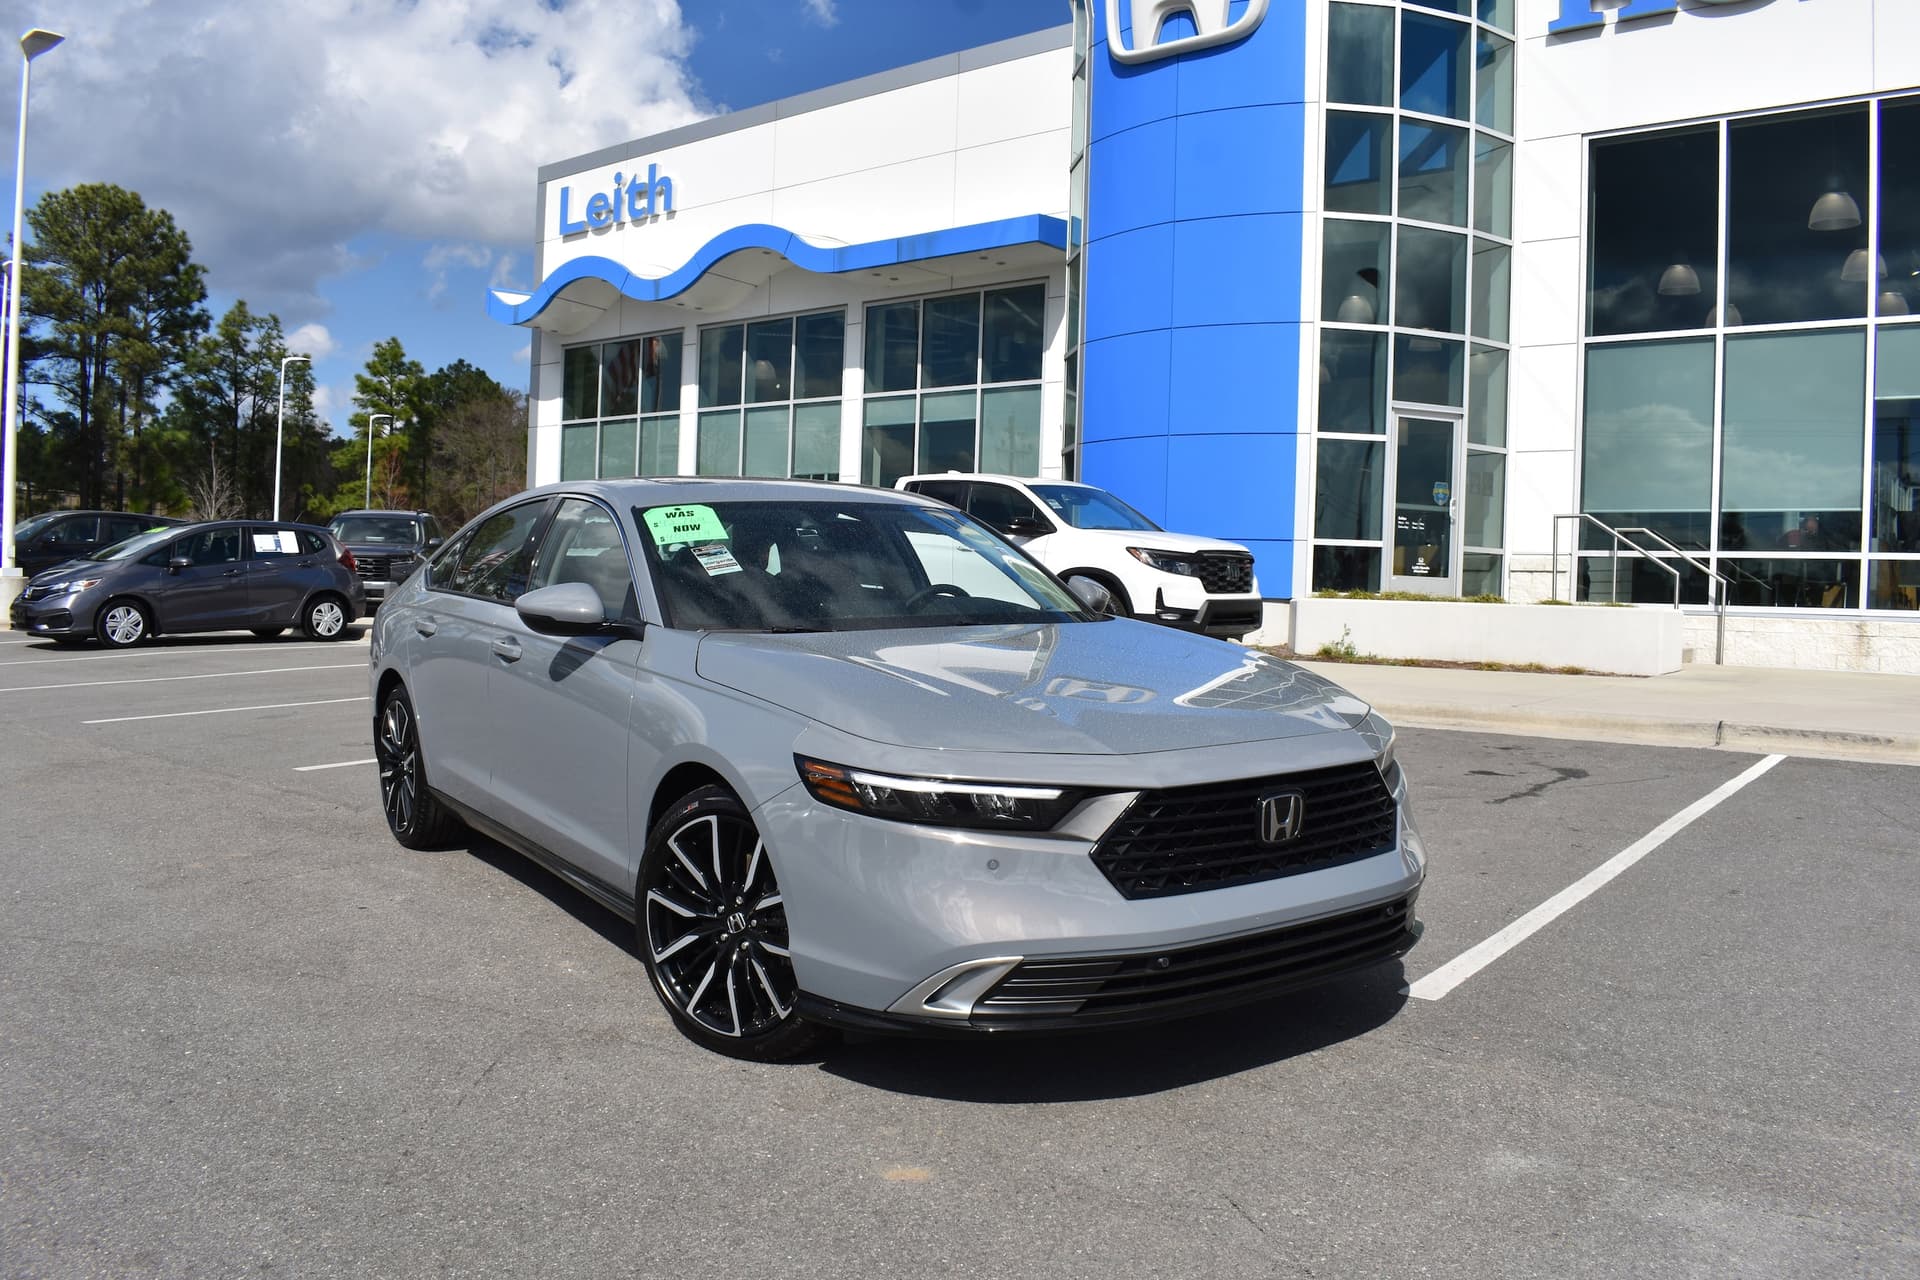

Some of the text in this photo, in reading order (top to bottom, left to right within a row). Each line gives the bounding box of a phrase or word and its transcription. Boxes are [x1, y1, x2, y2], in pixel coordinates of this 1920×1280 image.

[559, 163, 674, 235] Leith
[665, 510, 694, 518] WAS
[673, 524, 701, 532] NOW
